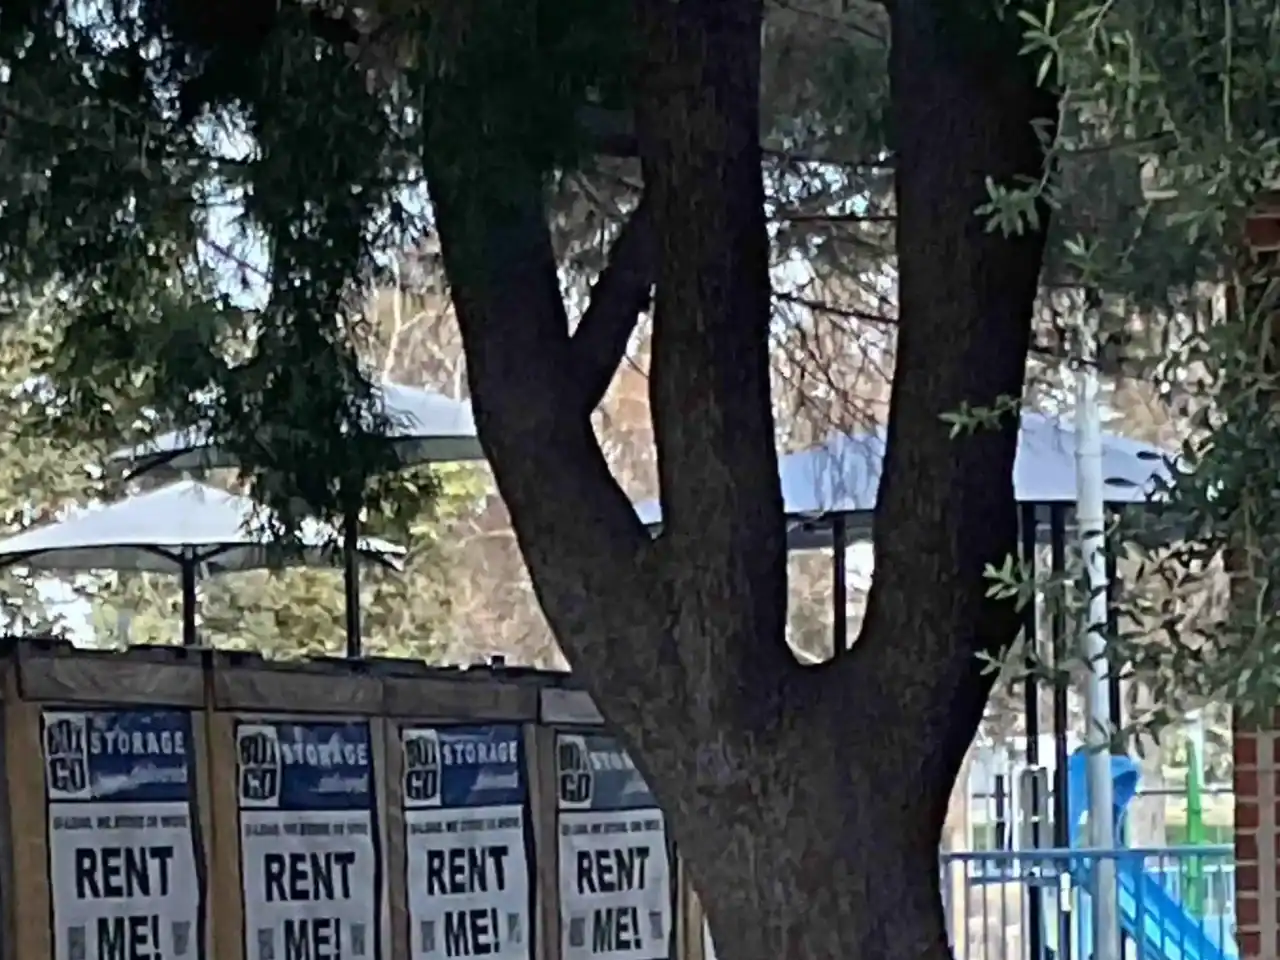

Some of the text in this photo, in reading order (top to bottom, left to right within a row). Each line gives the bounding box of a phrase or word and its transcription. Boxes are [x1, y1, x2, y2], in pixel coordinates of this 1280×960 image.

[90, 730, 186, 755] STORAGE
[443, 740, 518, 765] STORAGE
[75, 845, 174, 899] RENT
[264, 851, 356, 902] RENT
[426, 845, 508, 897] RENT
[577, 846, 650, 894] RENT
[444, 908, 500, 957] ME!
[592, 906, 642, 954] ME!
